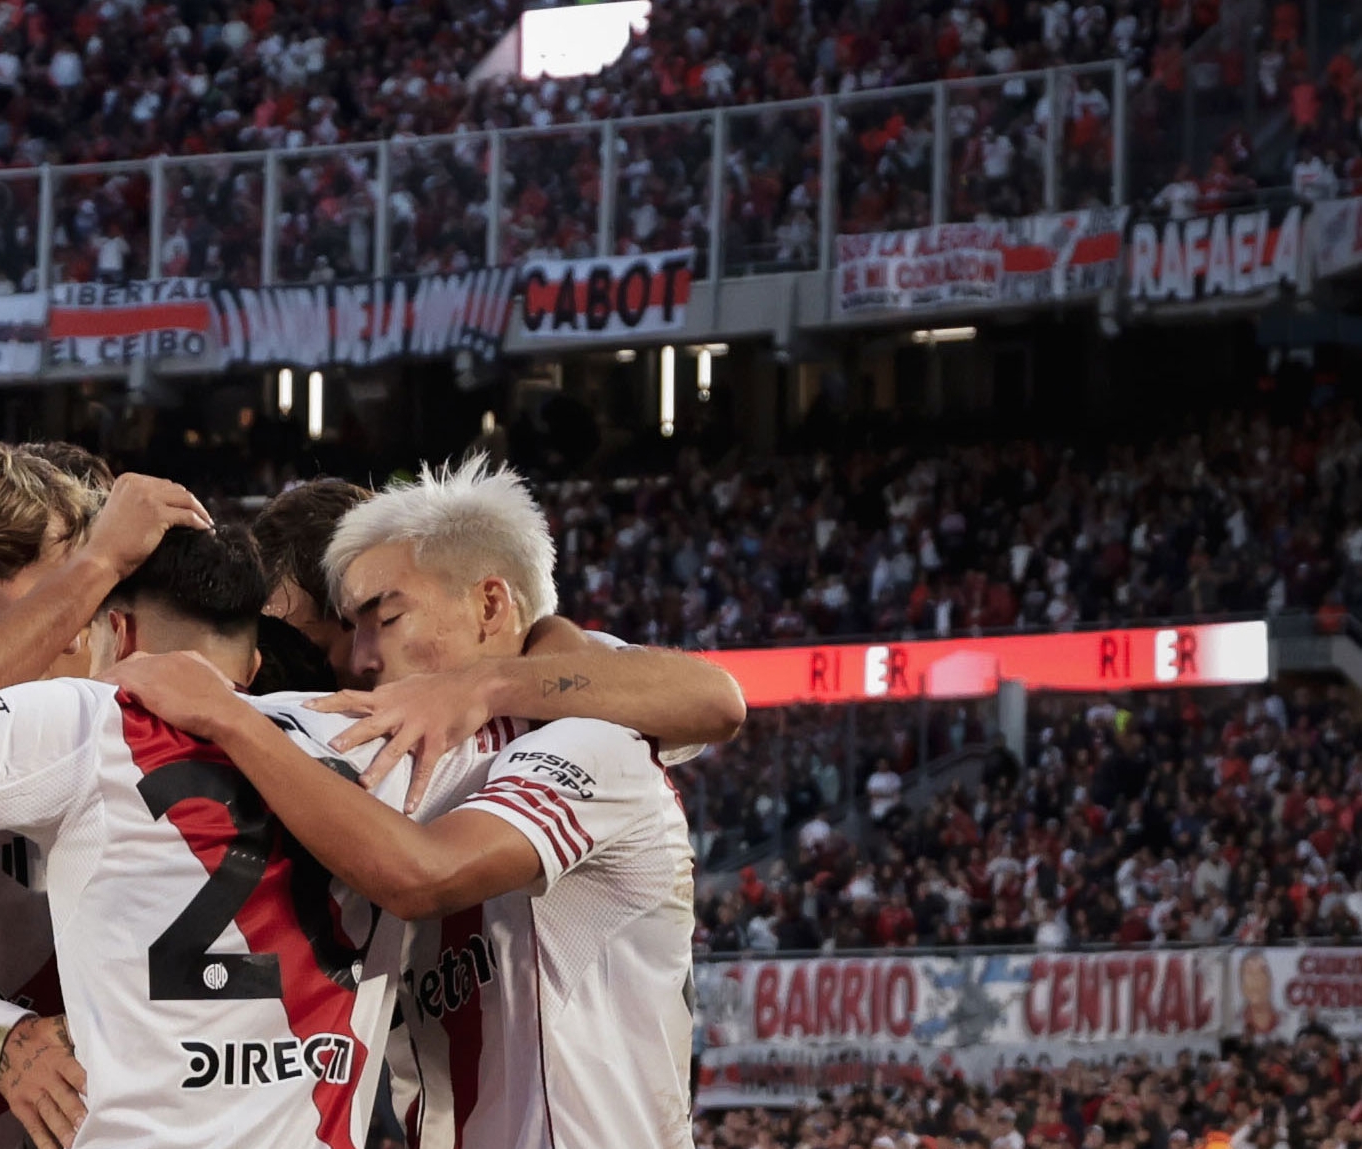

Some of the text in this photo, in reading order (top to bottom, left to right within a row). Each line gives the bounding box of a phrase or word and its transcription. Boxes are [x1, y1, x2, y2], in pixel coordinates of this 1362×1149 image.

[1130, 207, 1303, 298] RAFAELA
[523, 257, 689, 331] CABOT
[509, 751, 598, 787] ASSIST
[753, 955, 1215, 1039] BARRIO CENTRAL
[181, 1033, 354, 1089] DIRECT
